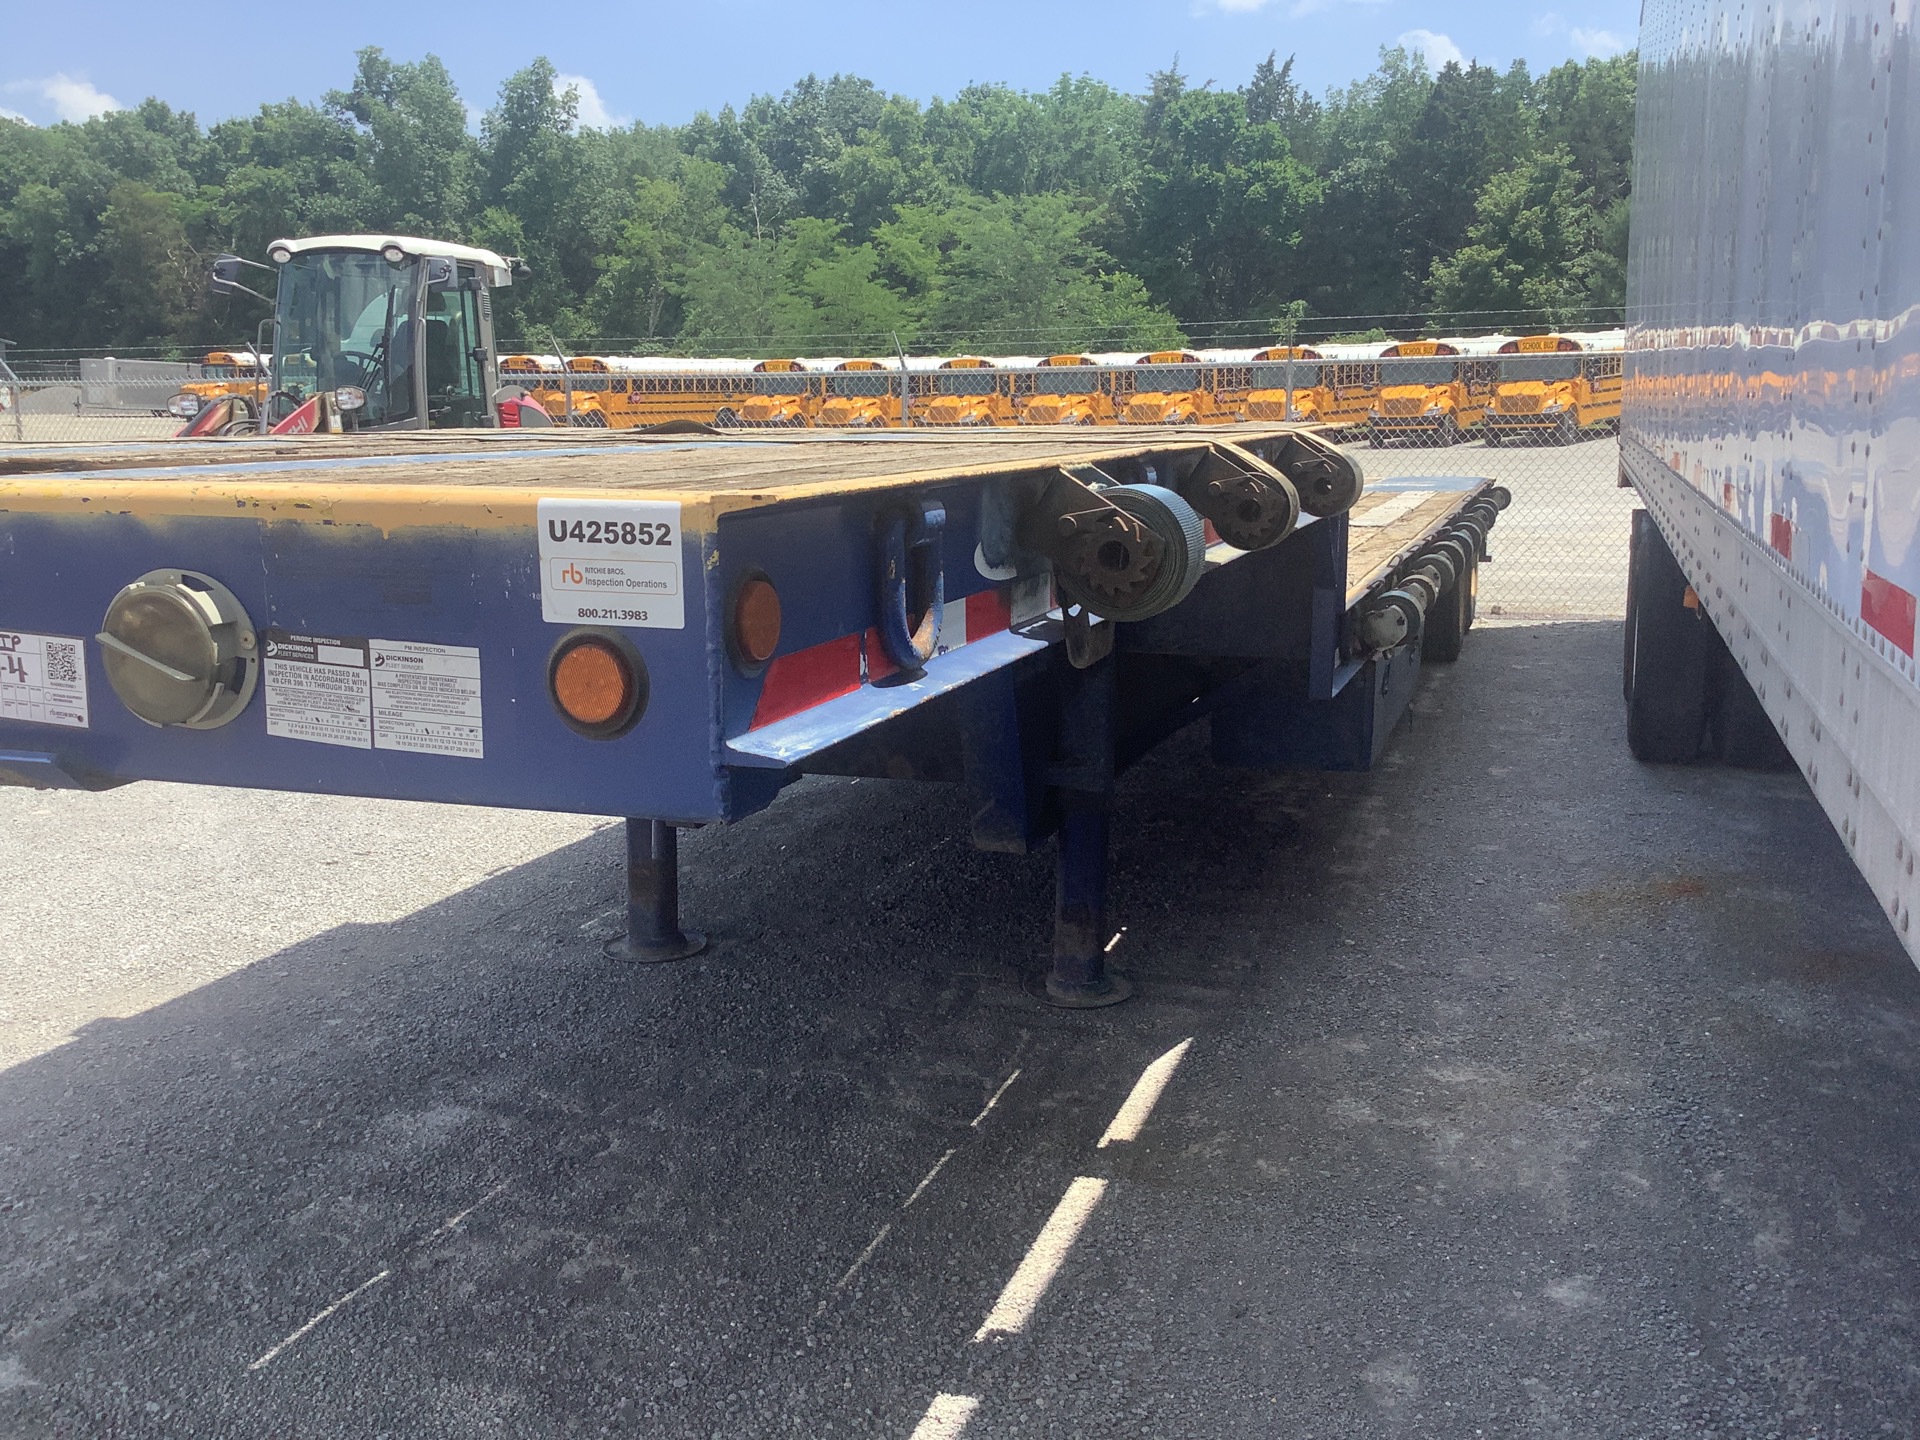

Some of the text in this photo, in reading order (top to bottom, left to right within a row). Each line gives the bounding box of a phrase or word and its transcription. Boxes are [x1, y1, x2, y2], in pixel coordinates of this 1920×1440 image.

[1523, 342, 1542, 350] SCHOOL
[549, 520, 671, 546] U425852
[562, 563, 583, 584] rb
[585, 577, 667, 589] Inspection Operations
[578, 608, 648, 620] 800.211.3983
[313, 637, 340, 645] INSPECTION
[278, 643, 313, 652] DICKINSON
[386, 655, 423, 664] DICKINSON
[290, 665, 312, 674] VEHICLE
[328, 669, 350, 678] PASSED
[268, 670, 302, 680] INSPECTION
[311, 674, 350, 685] ACCORDANCE
[352, 679, 368, 687] WITH
[314, 682, 342, 691] THROUGH
